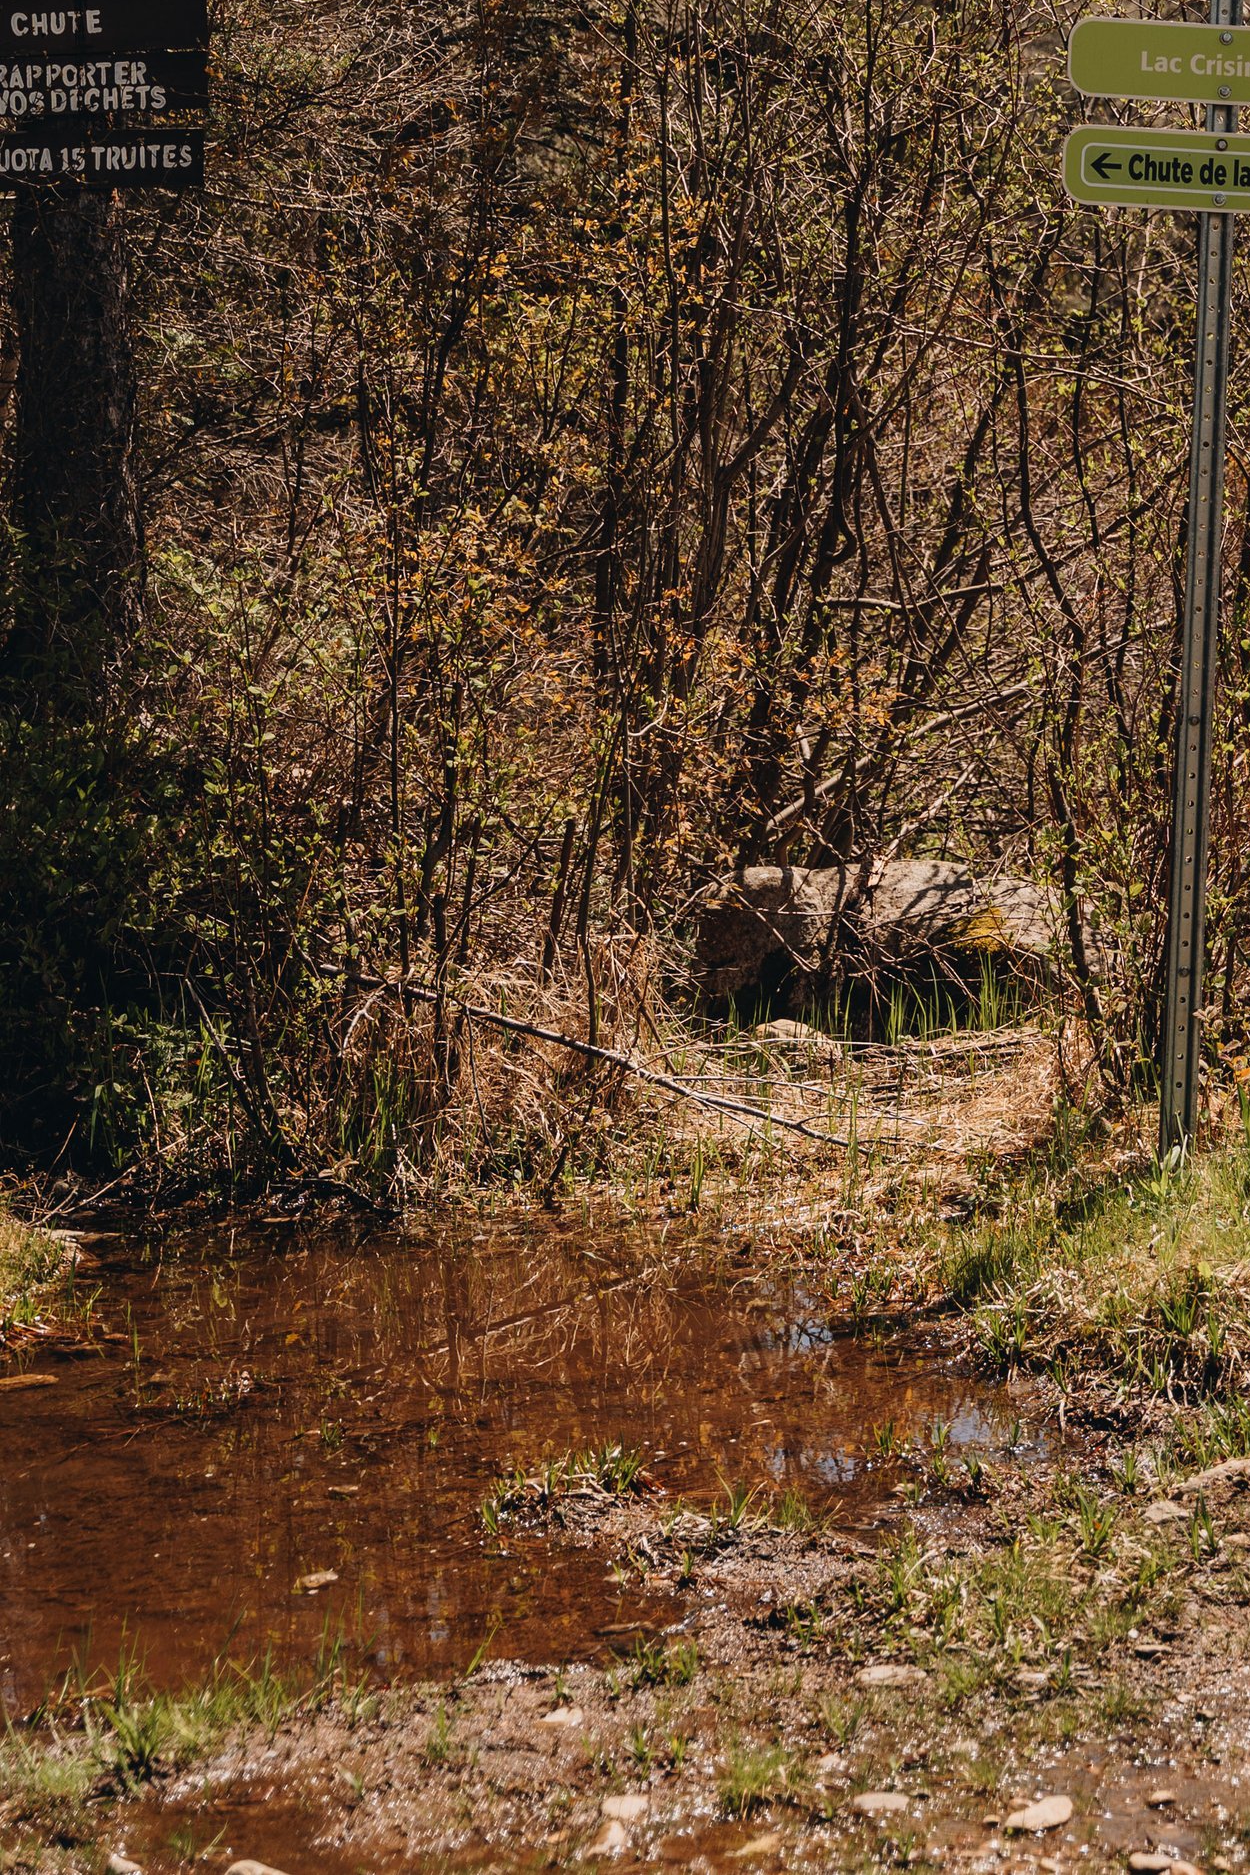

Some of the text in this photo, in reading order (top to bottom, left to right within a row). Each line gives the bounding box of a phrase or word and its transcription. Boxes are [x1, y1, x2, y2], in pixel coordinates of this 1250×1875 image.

[11, 10, 103, 36] CHUTE
[0, 61, 147, 89] RAPPORTER
[1140, 51, 1182, 74] Lac
[0, 89, 45, 117] VOS
[60, 147, 86, 171] 15
[1128, 153, 1194, 184] Chute
[1199, 158, 1228, 186] de
[1233, 159, 1250, 187] la
